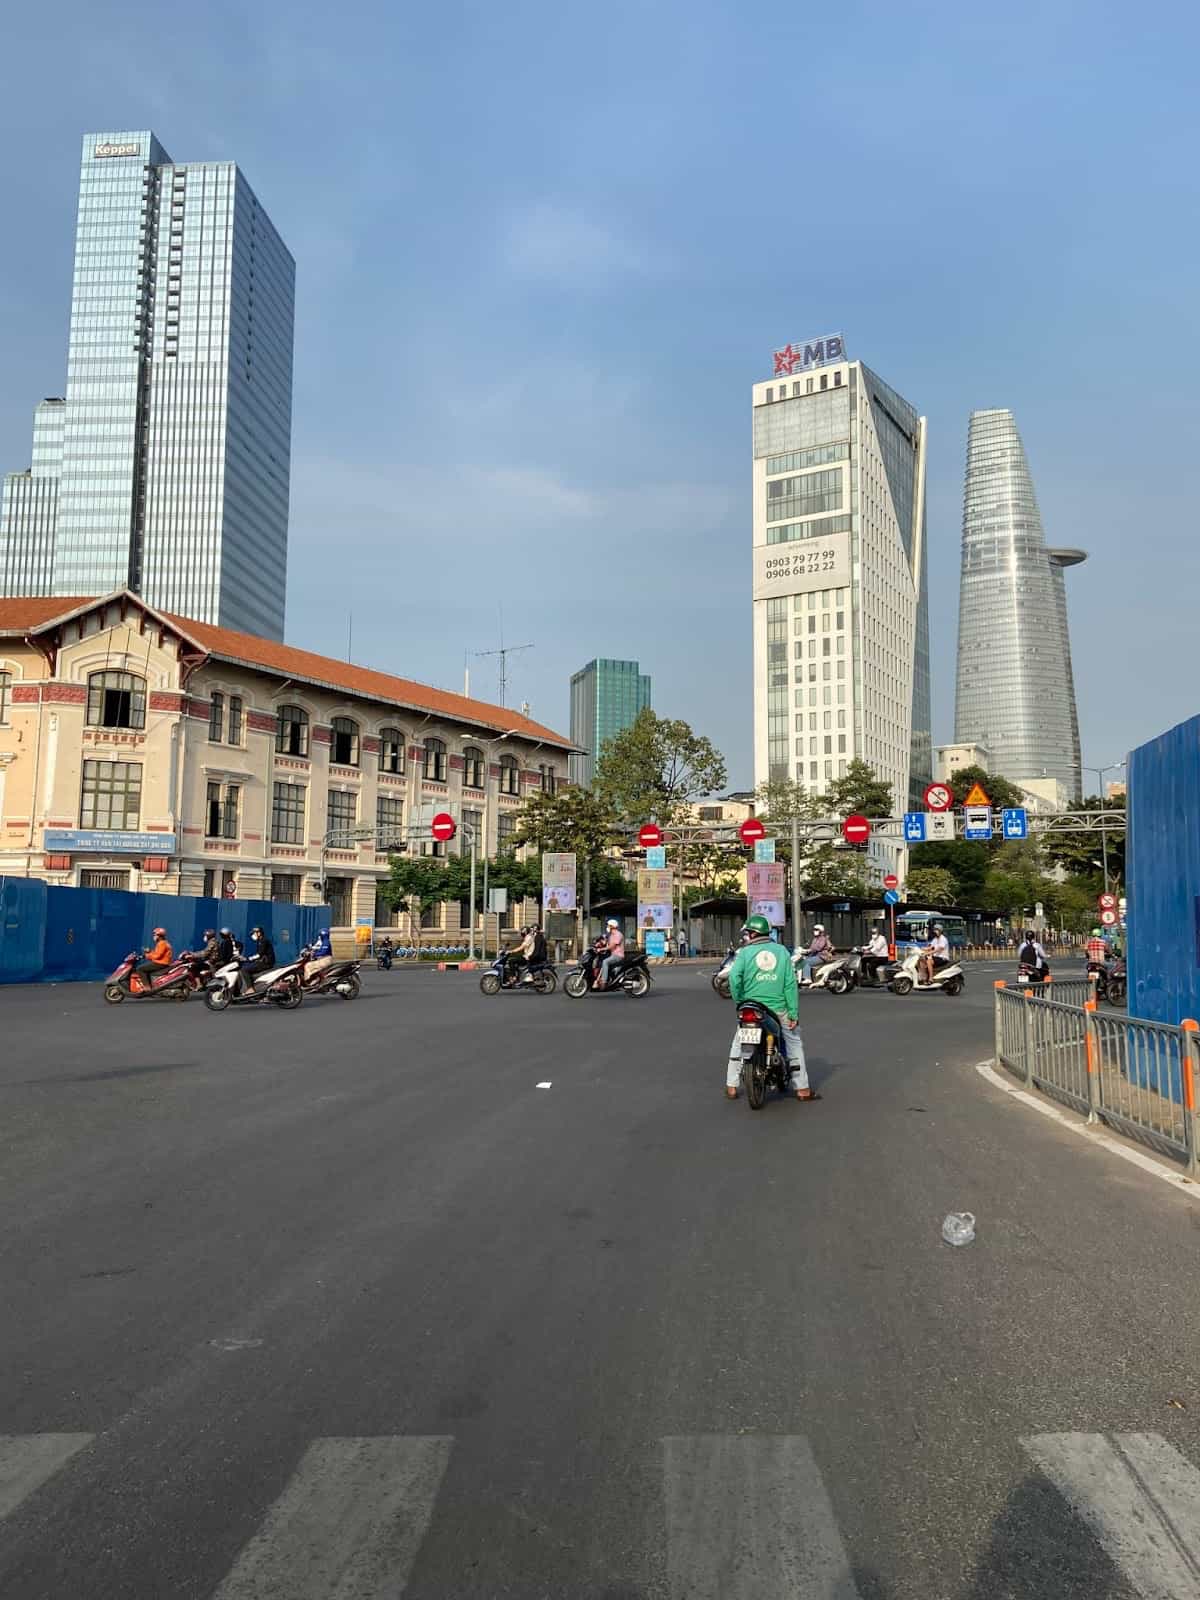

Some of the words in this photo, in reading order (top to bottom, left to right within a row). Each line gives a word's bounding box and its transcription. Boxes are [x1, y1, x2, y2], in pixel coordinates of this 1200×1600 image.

[804, 337, 842, 365] MB
[766, 557, 790, 569] 0903
[793, 554, 805, 564] 79
[808, 552, 820, 562] 77
[822, 550, 835, 560] 99
[766, 568, 791, 579] 0906
[807, 563, 820, 573] 22
[822, 561, 835, 571] 22
